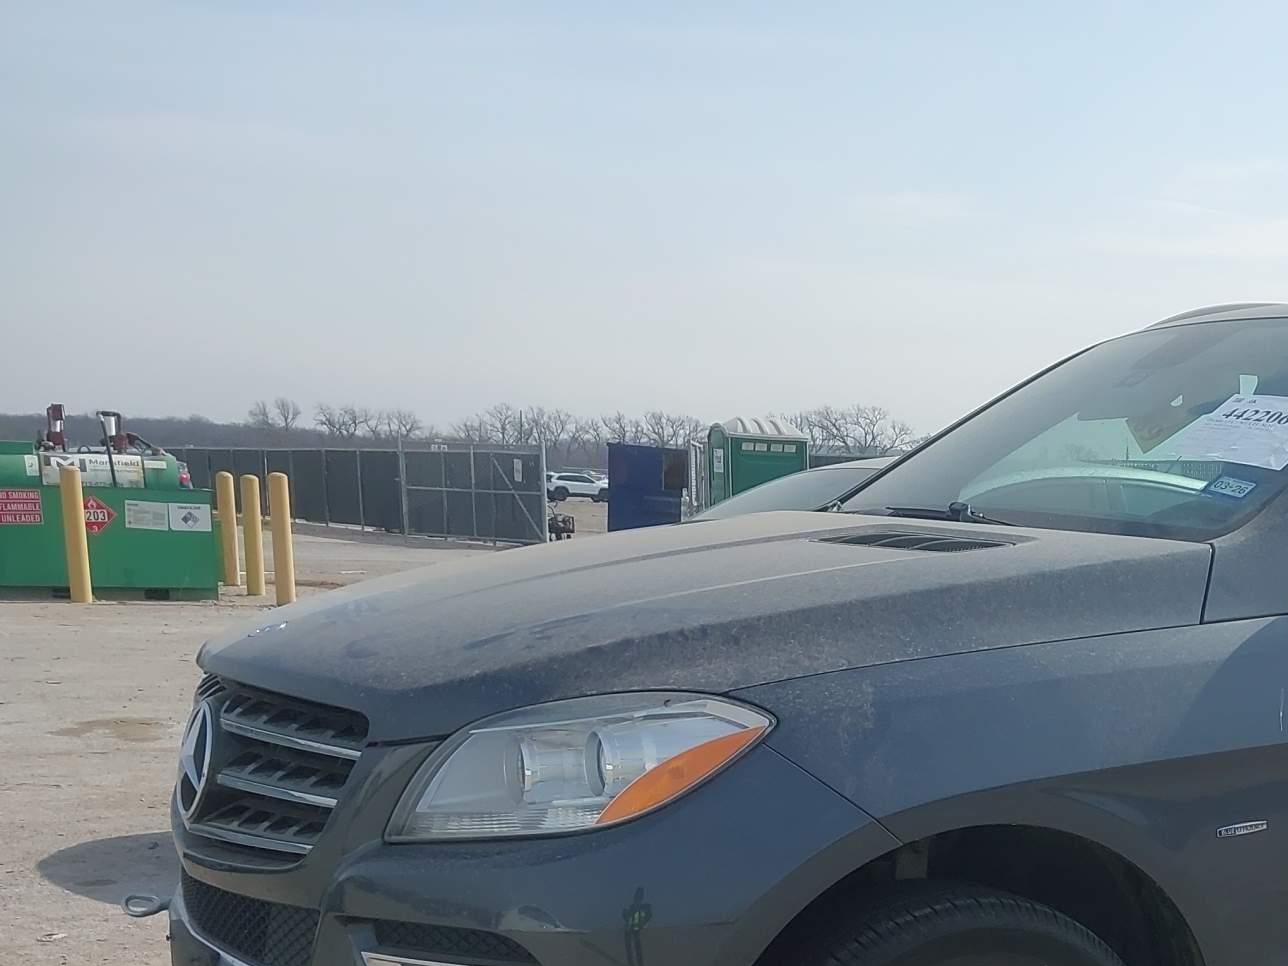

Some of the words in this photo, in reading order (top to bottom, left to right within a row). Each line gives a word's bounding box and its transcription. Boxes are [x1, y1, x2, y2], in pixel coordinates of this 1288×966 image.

[8, 491, 39, 499] SMOKING
[0, 503, 40, 511] FLAMMABLE
[1, 514, 41, 522] UNLEADED
[85, 510, 106, 521] 203
